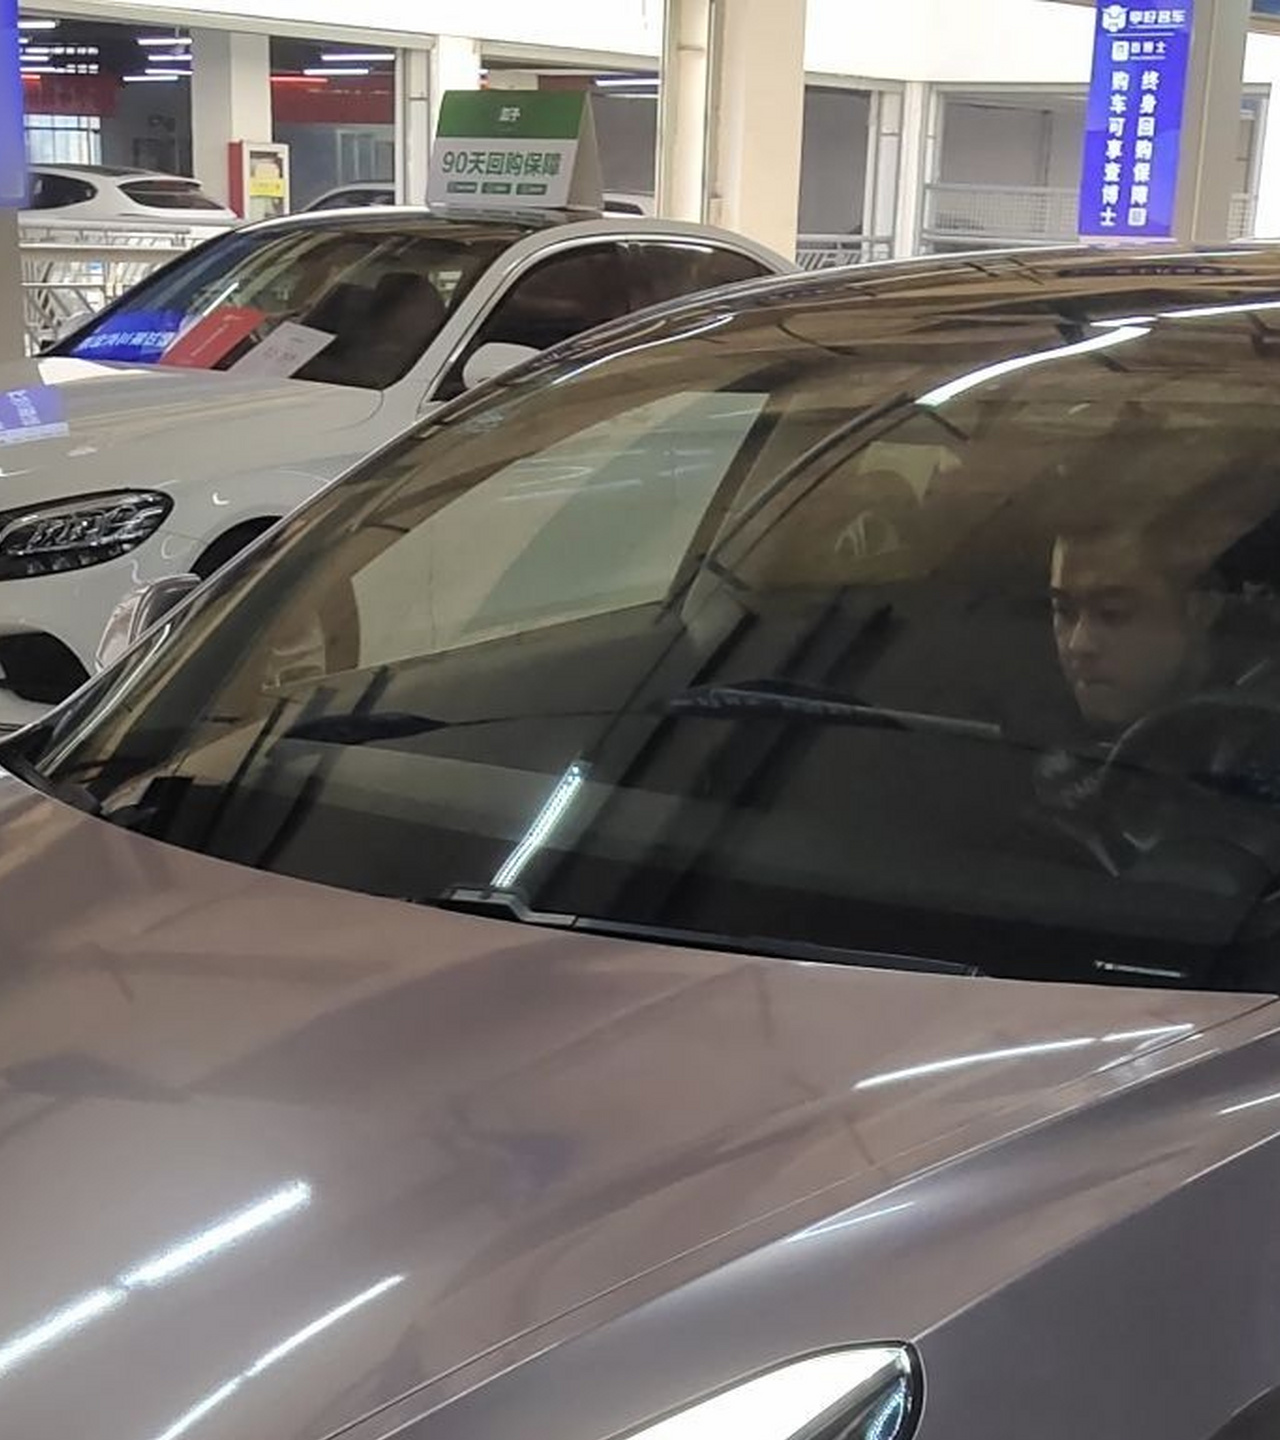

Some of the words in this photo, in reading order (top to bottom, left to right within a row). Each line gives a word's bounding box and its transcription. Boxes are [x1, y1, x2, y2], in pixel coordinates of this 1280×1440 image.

[441, 151, 562, 176] 90天回购保障
[1099, 70, 1130, 227] 购车可享查博士
[1131, 70, 1160, 205] 终身回购保障
